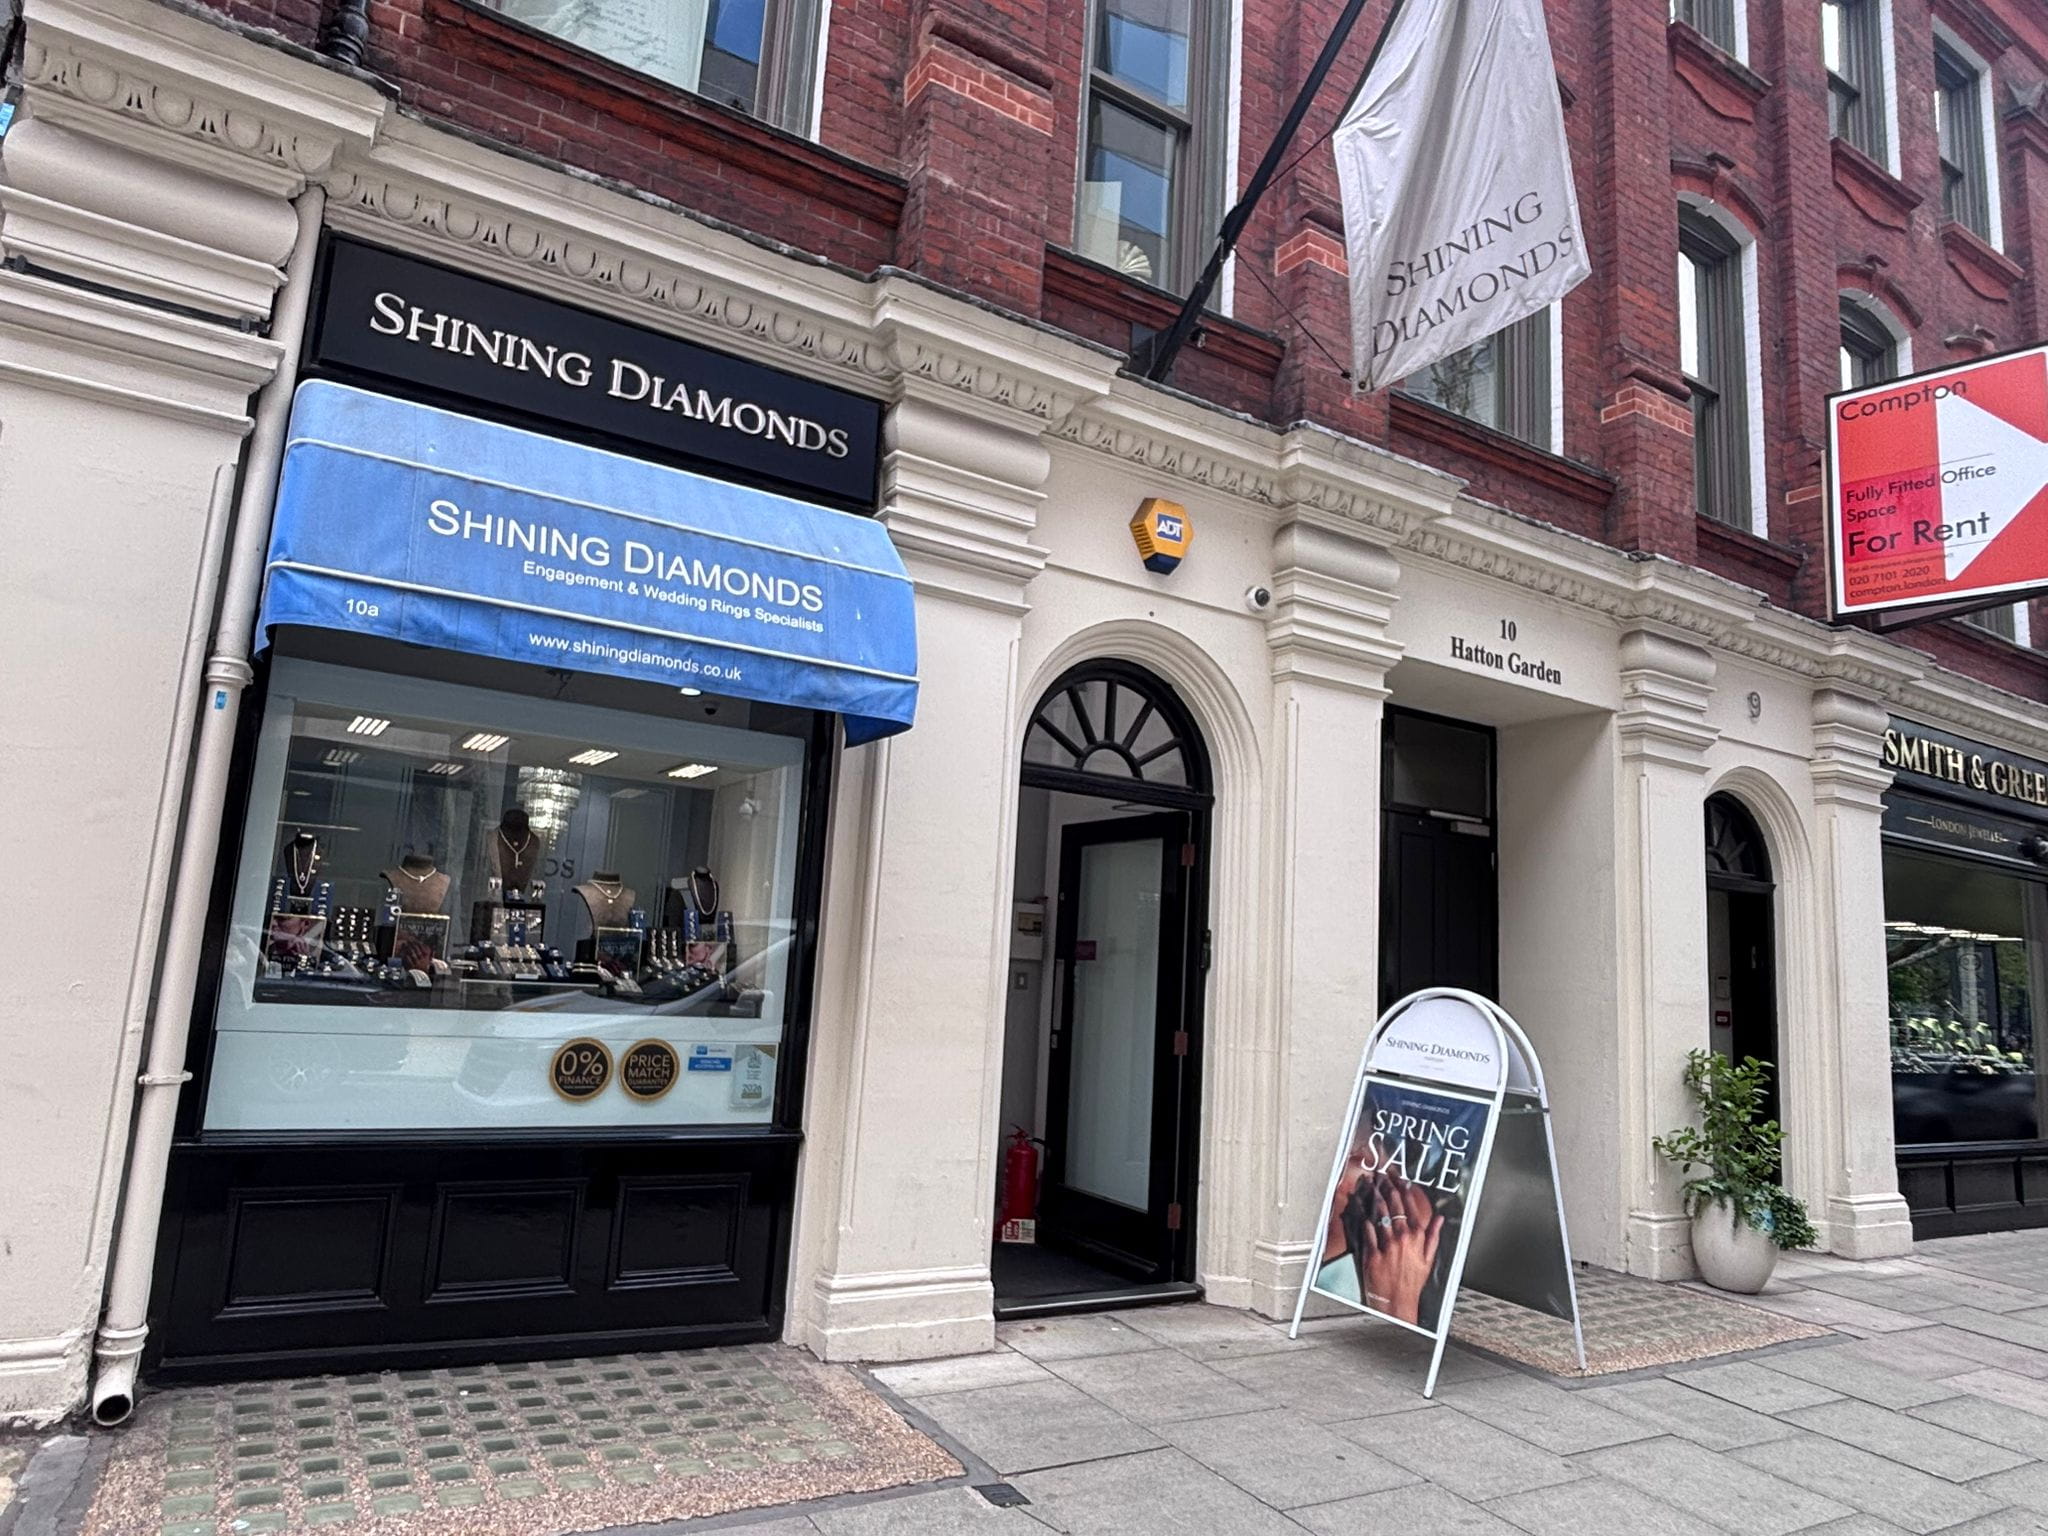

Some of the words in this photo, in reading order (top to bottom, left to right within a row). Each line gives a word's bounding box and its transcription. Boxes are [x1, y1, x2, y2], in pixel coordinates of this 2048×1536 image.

[1386, 191, 1543, 297] SHINING
[1372, 225, 1574, 358] DIAMONDS
[370, 292, 593, 387] SHINING
[607, 358, 849, 458] DIAMONDS
[1840, 379, 1967, 421] Compton
[1846, 486, 1883, 504] Fully
[1888, 474, 1936, 496] Fitted
[1941, 463, 1997, 484] Office
[1157, 519, 1183, 538] ADT
[1846, 504, 1897, 523] Space
[1848, 528, 1902, 557] For
[1913, 511, 1991, 546] Rent
[428, 499, 610, 567] SHINING
[624, 541, 824, 612] DIAMONDS
[1849, 575, 1870, 586] 020
[1873, 570, 1897, 583] 7101
[1902, 565, 1931, 578] 2020
[346, 598, 379, 617] 10a
[523, 560, 624, 593] Engagement
[627, 582, 639, 595] &
[643, 584, 707, 611] Wedding
[711, 598, 751, 619] Rings
[754, 607, 824, 633] Specialists
[1850, 576, 1947, 598] compton.london
[1500, 619, 1517, 642] 10
[529, 633, 742, 681] www.shiningdiamonds.co.uk
[1451, 636, 1504, 670] Hatton
[1508, 652, 1562, 685] Garden
[1747, 691, 1761, 718] 9
[1884, 728, 1966, 784] SMITH
[1970, 755, 1988, 790] &
[1991, 761, 2048, 806] GREE
[560, 1050, 604, 1076] 0%
[629, 1054, 671, 1067] PRICE
[1386, 1036, 1429, 1054] SHINING
[1431, 1044, 1491, 1064] DIAMONDS
[558, 1075, 602, 1086] FINANCE
[627, 1067, 671, 1079] MATCH
[1373, 1109, 1470, 1151] SPRING
[1360, 1131, 1466, 1194] SALE
